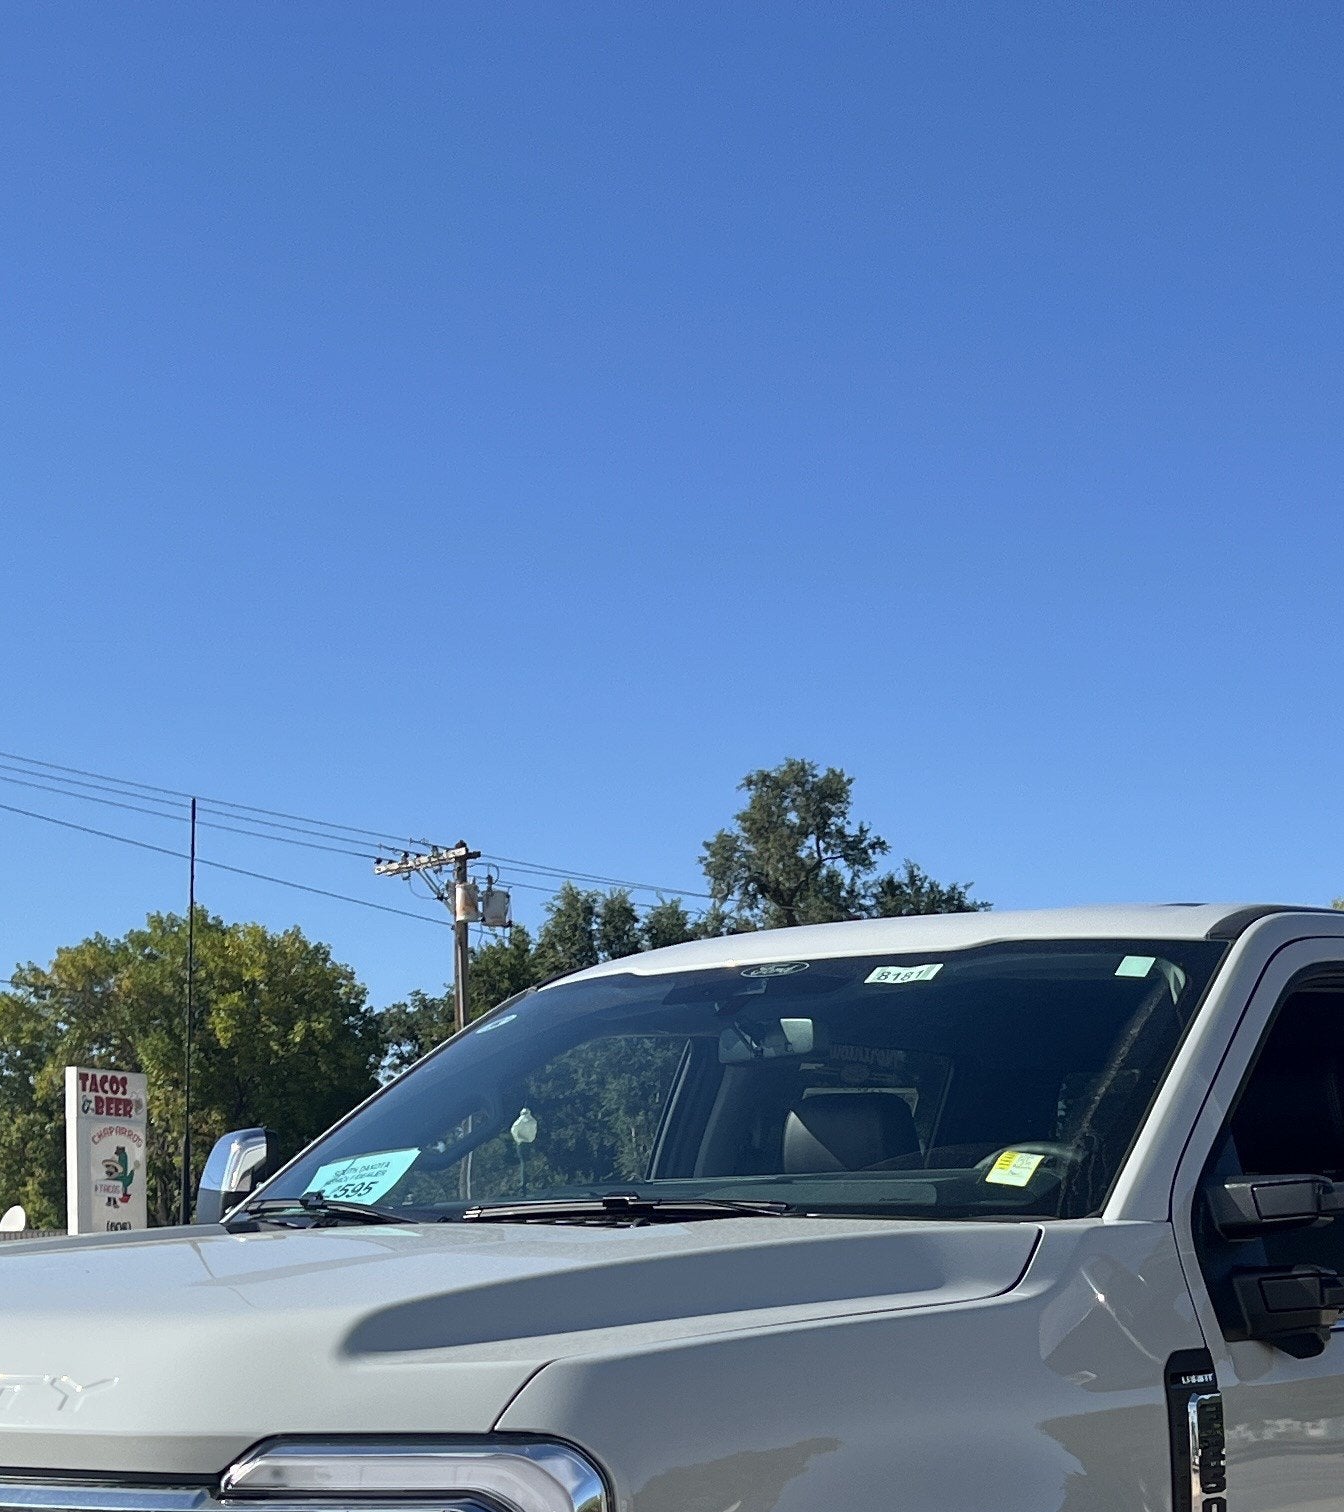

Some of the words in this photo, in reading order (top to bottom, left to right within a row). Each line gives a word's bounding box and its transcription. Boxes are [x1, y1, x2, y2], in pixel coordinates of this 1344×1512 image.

[875, 969, 926, 982] 8181
[79, 1072, 128, 1095] TACOS
[94, 1095, 133, 1118] BEER
